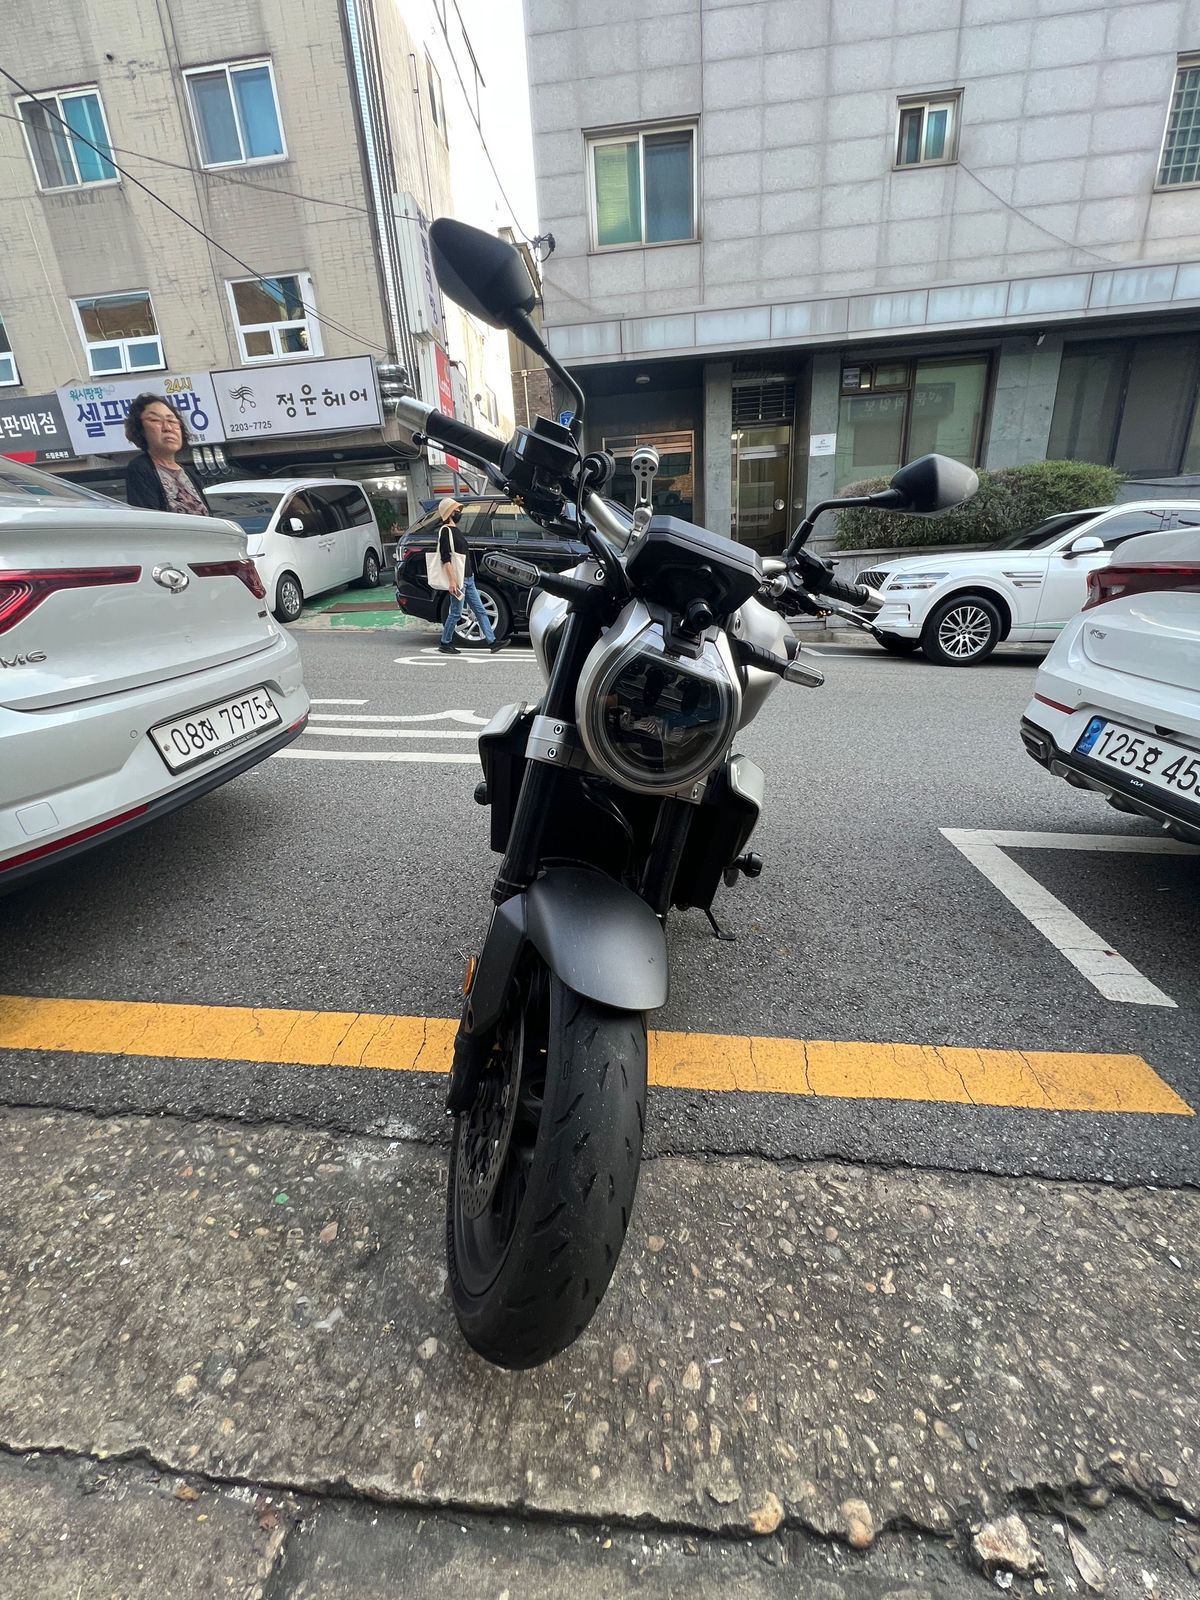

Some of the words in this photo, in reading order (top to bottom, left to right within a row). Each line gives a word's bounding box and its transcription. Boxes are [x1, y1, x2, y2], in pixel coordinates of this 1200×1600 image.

[164, 376, 194, 394] 24시
[276, 384, 368, 418] 정윤헤어
[0, 411, 57, 438] 판매점
[76, 391, 209, 438] 셀프방
[230, 420, 272, 433] 2203-7725
[170, 717, 219, 756] 08허
[218, 696, 268, 734] 7975
[1098, 729, 1163, 775] 125호
